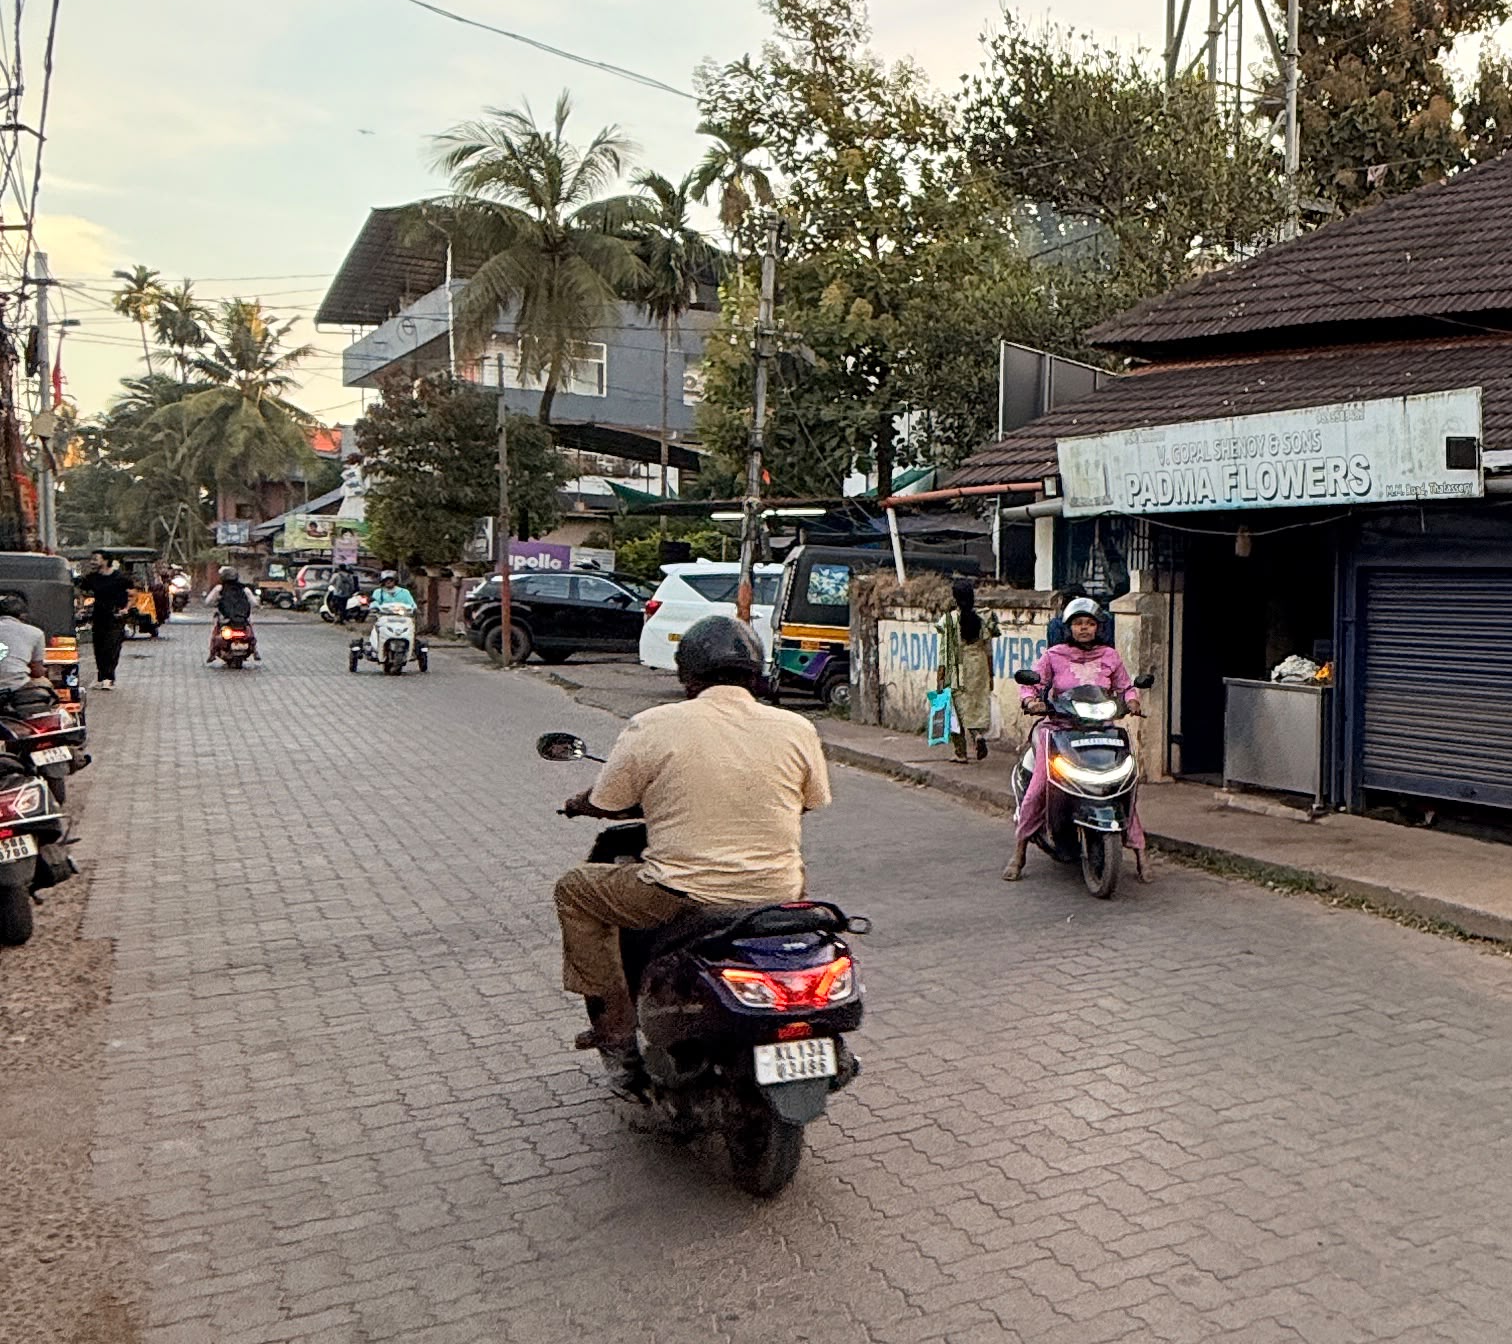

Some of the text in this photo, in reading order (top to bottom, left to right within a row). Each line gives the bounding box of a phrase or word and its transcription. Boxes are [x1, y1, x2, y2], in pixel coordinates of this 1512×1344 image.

[1156, 429, 1322, 466] V. GOPAL SHENOY & SONS
[1124, 453, 1372, 507] PADMA FLOWERS
[508, 552, 562, 570] pollo
[889, 631, 938, 672] PADM
